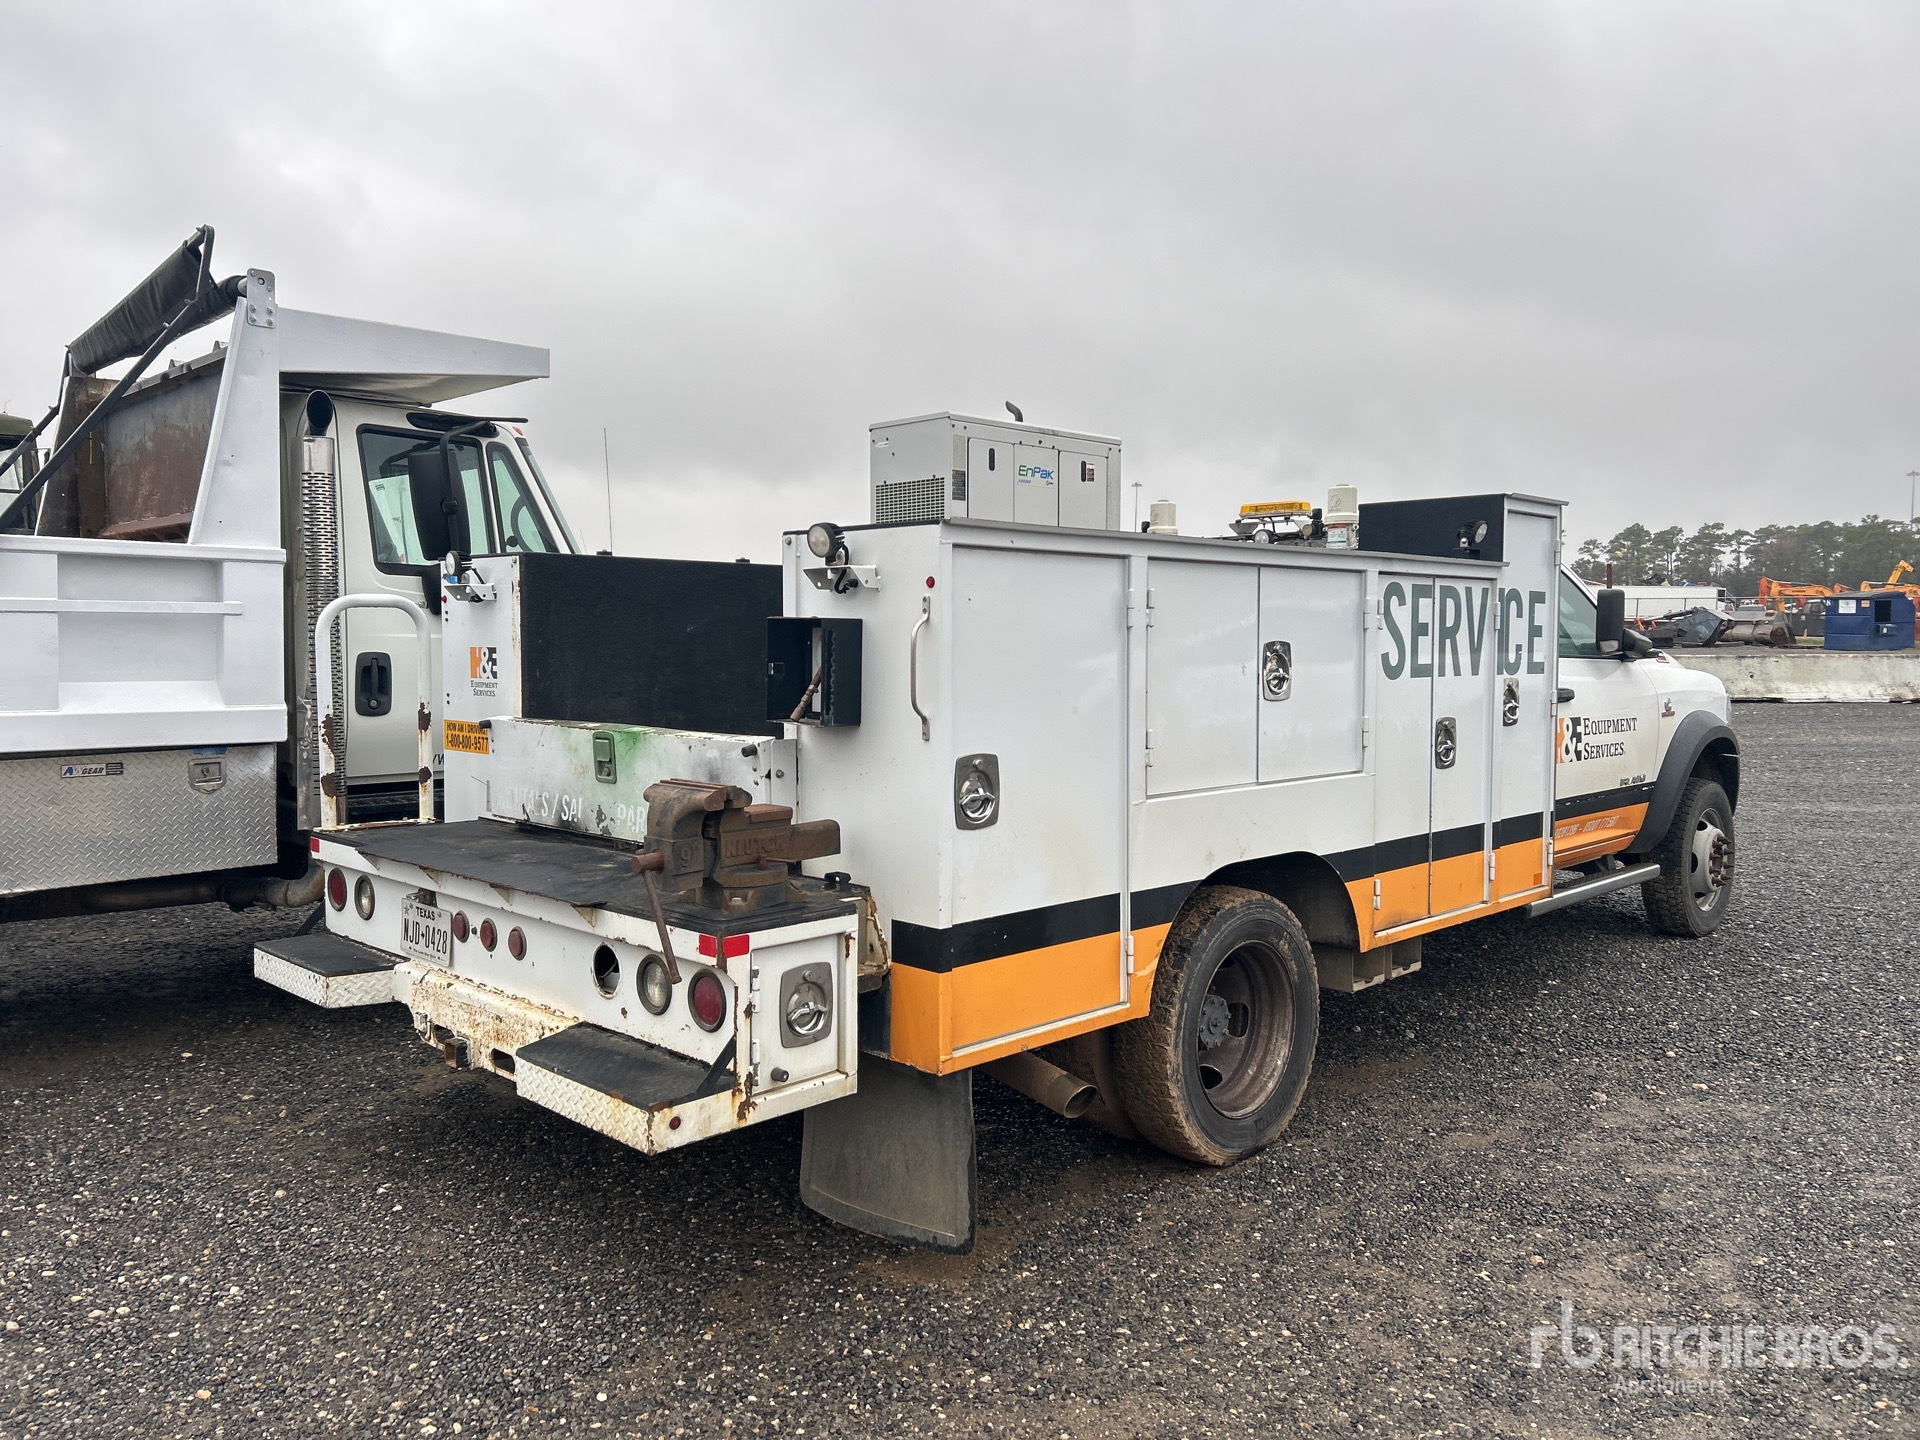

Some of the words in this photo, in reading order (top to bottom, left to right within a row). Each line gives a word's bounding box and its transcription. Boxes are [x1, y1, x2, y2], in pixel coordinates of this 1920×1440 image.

[1018, 464, 1054, 480] EnPak
[1381, 581, 1546, 681] SERVICE
[469, 646, 498, 679] H&E
[446, 722, 457, 732] HOW
[446, 733, 489, 752] 1-800-800-9577
[82, 767, 104, 775] GEAR
[416, 906, 436, 921] TEXAS
